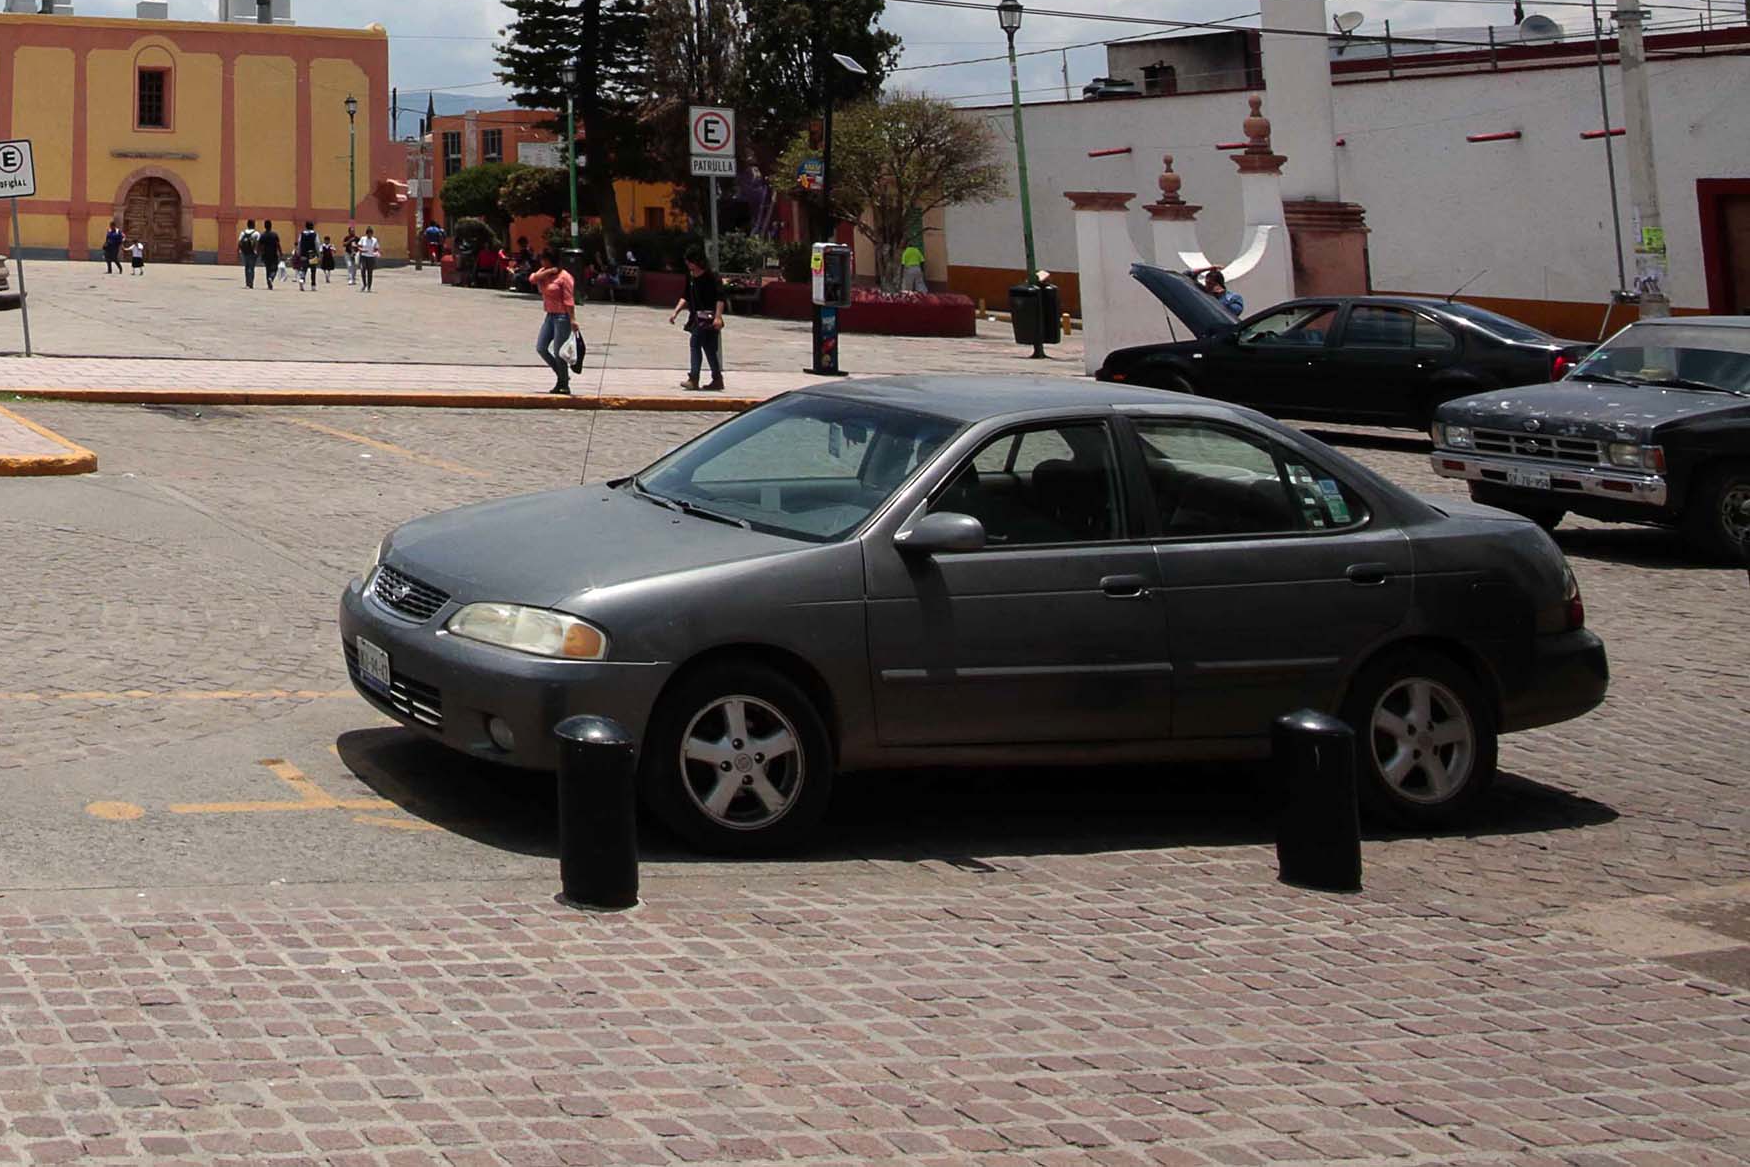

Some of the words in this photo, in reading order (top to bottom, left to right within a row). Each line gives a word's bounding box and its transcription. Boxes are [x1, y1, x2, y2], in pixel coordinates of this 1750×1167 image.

[704, 119, 721, 144] E
[2, 150, 17, 167] E
[693, 160, 734, 172] PATRULLA
[0, 178, 27, 189] OFICIAL
